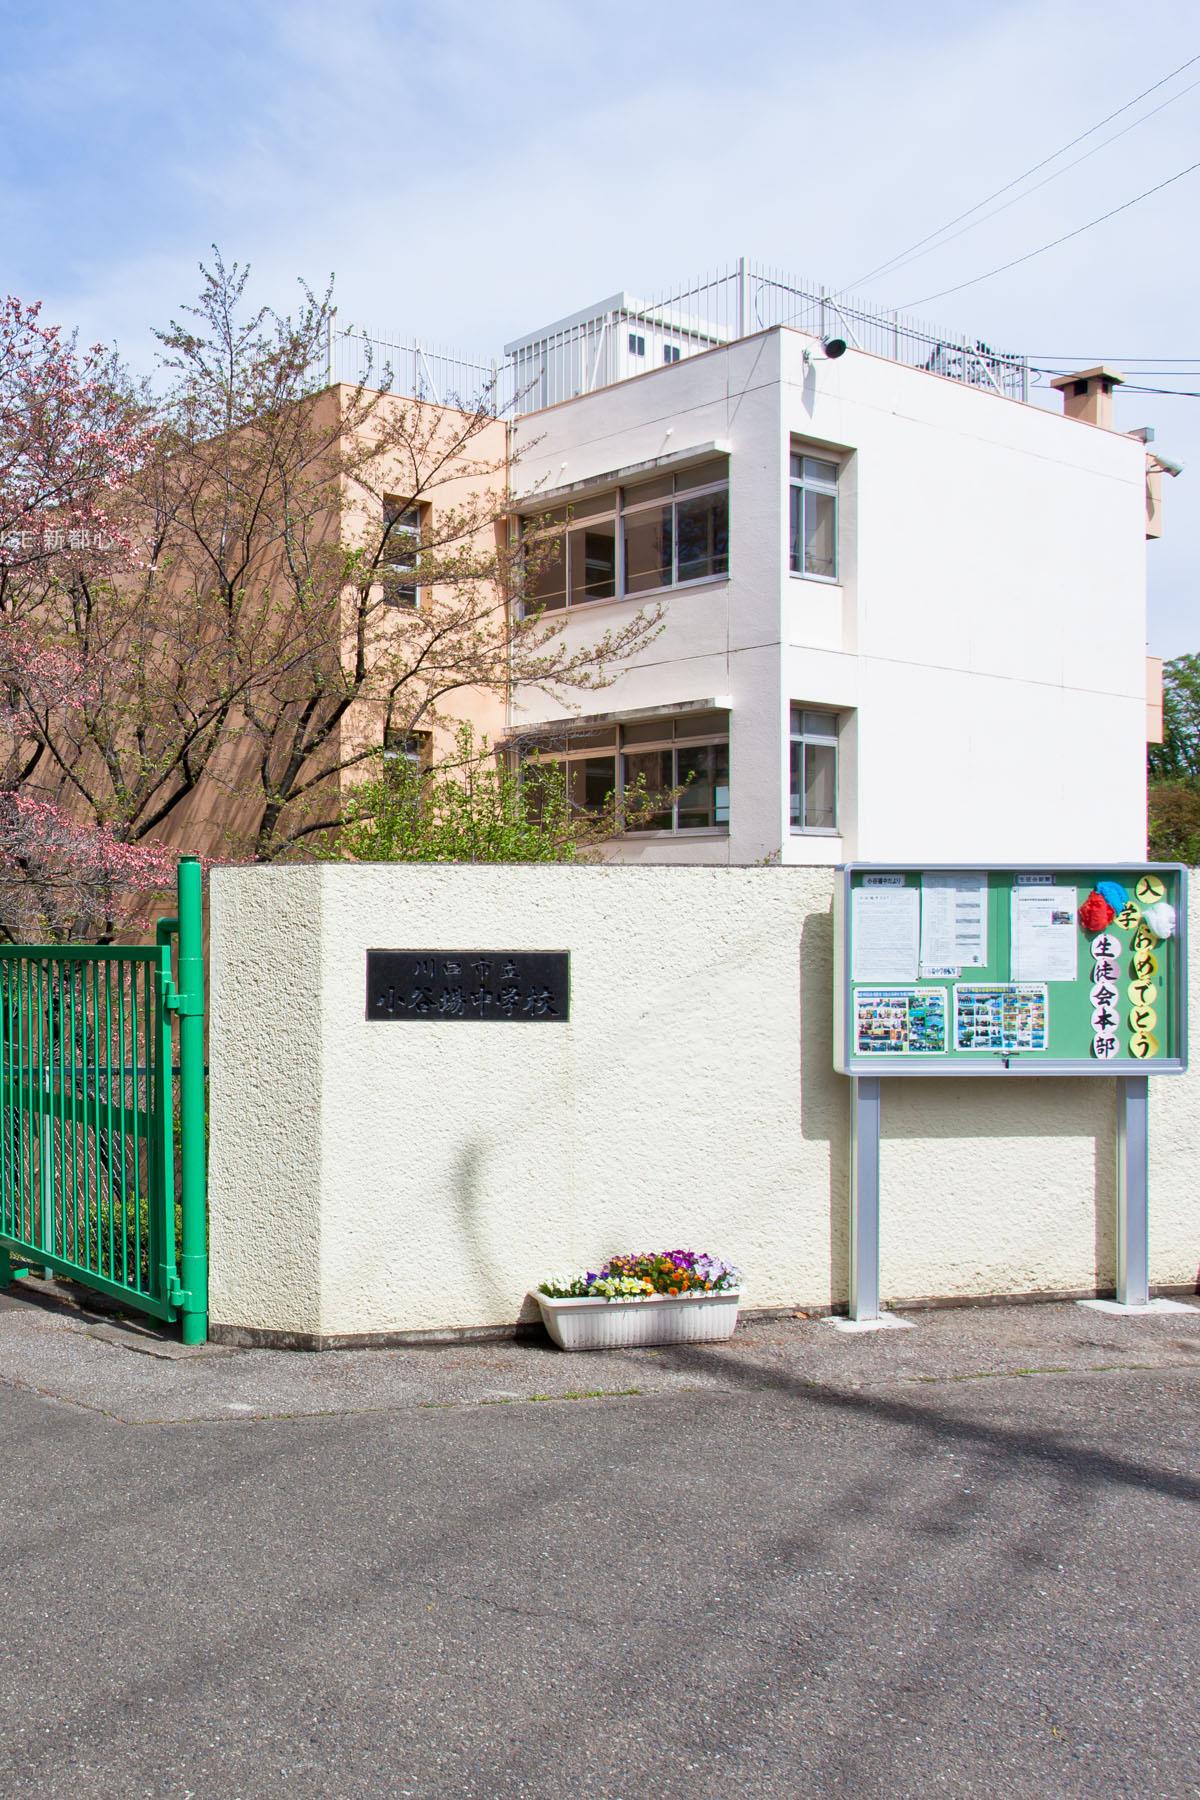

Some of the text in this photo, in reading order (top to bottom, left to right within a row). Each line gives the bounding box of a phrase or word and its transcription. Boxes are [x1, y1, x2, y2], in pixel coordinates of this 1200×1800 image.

[413, 957, 521, 980] 川口市立
[376, 984, 560, 1016] 小谷場中学校
[1094, 934, 1117, 1058] 生徒会本部
